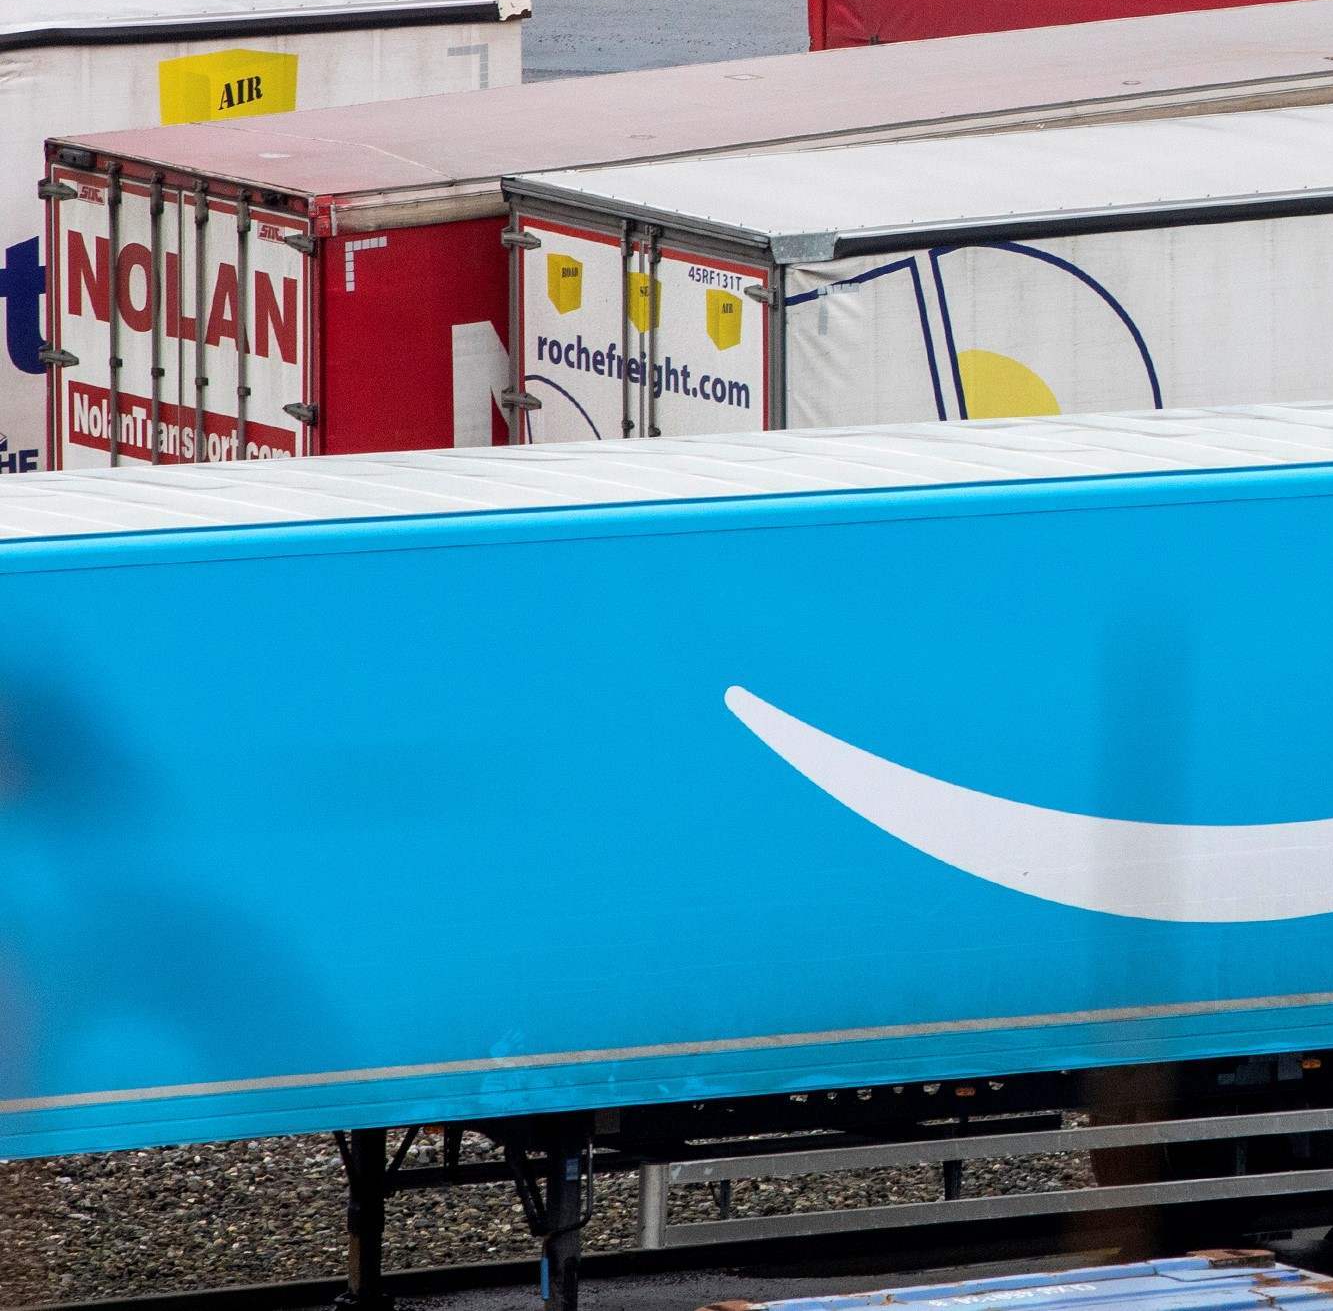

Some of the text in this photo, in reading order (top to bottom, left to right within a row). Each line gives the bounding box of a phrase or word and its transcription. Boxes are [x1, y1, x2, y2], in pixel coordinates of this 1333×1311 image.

[218, 74, 263, 111] AIR
[68, 229, 297, 365] NOLAN
[688, 266, 742, 292] 45RF131T
[537, 334, 750, 410] rochefreight.com
